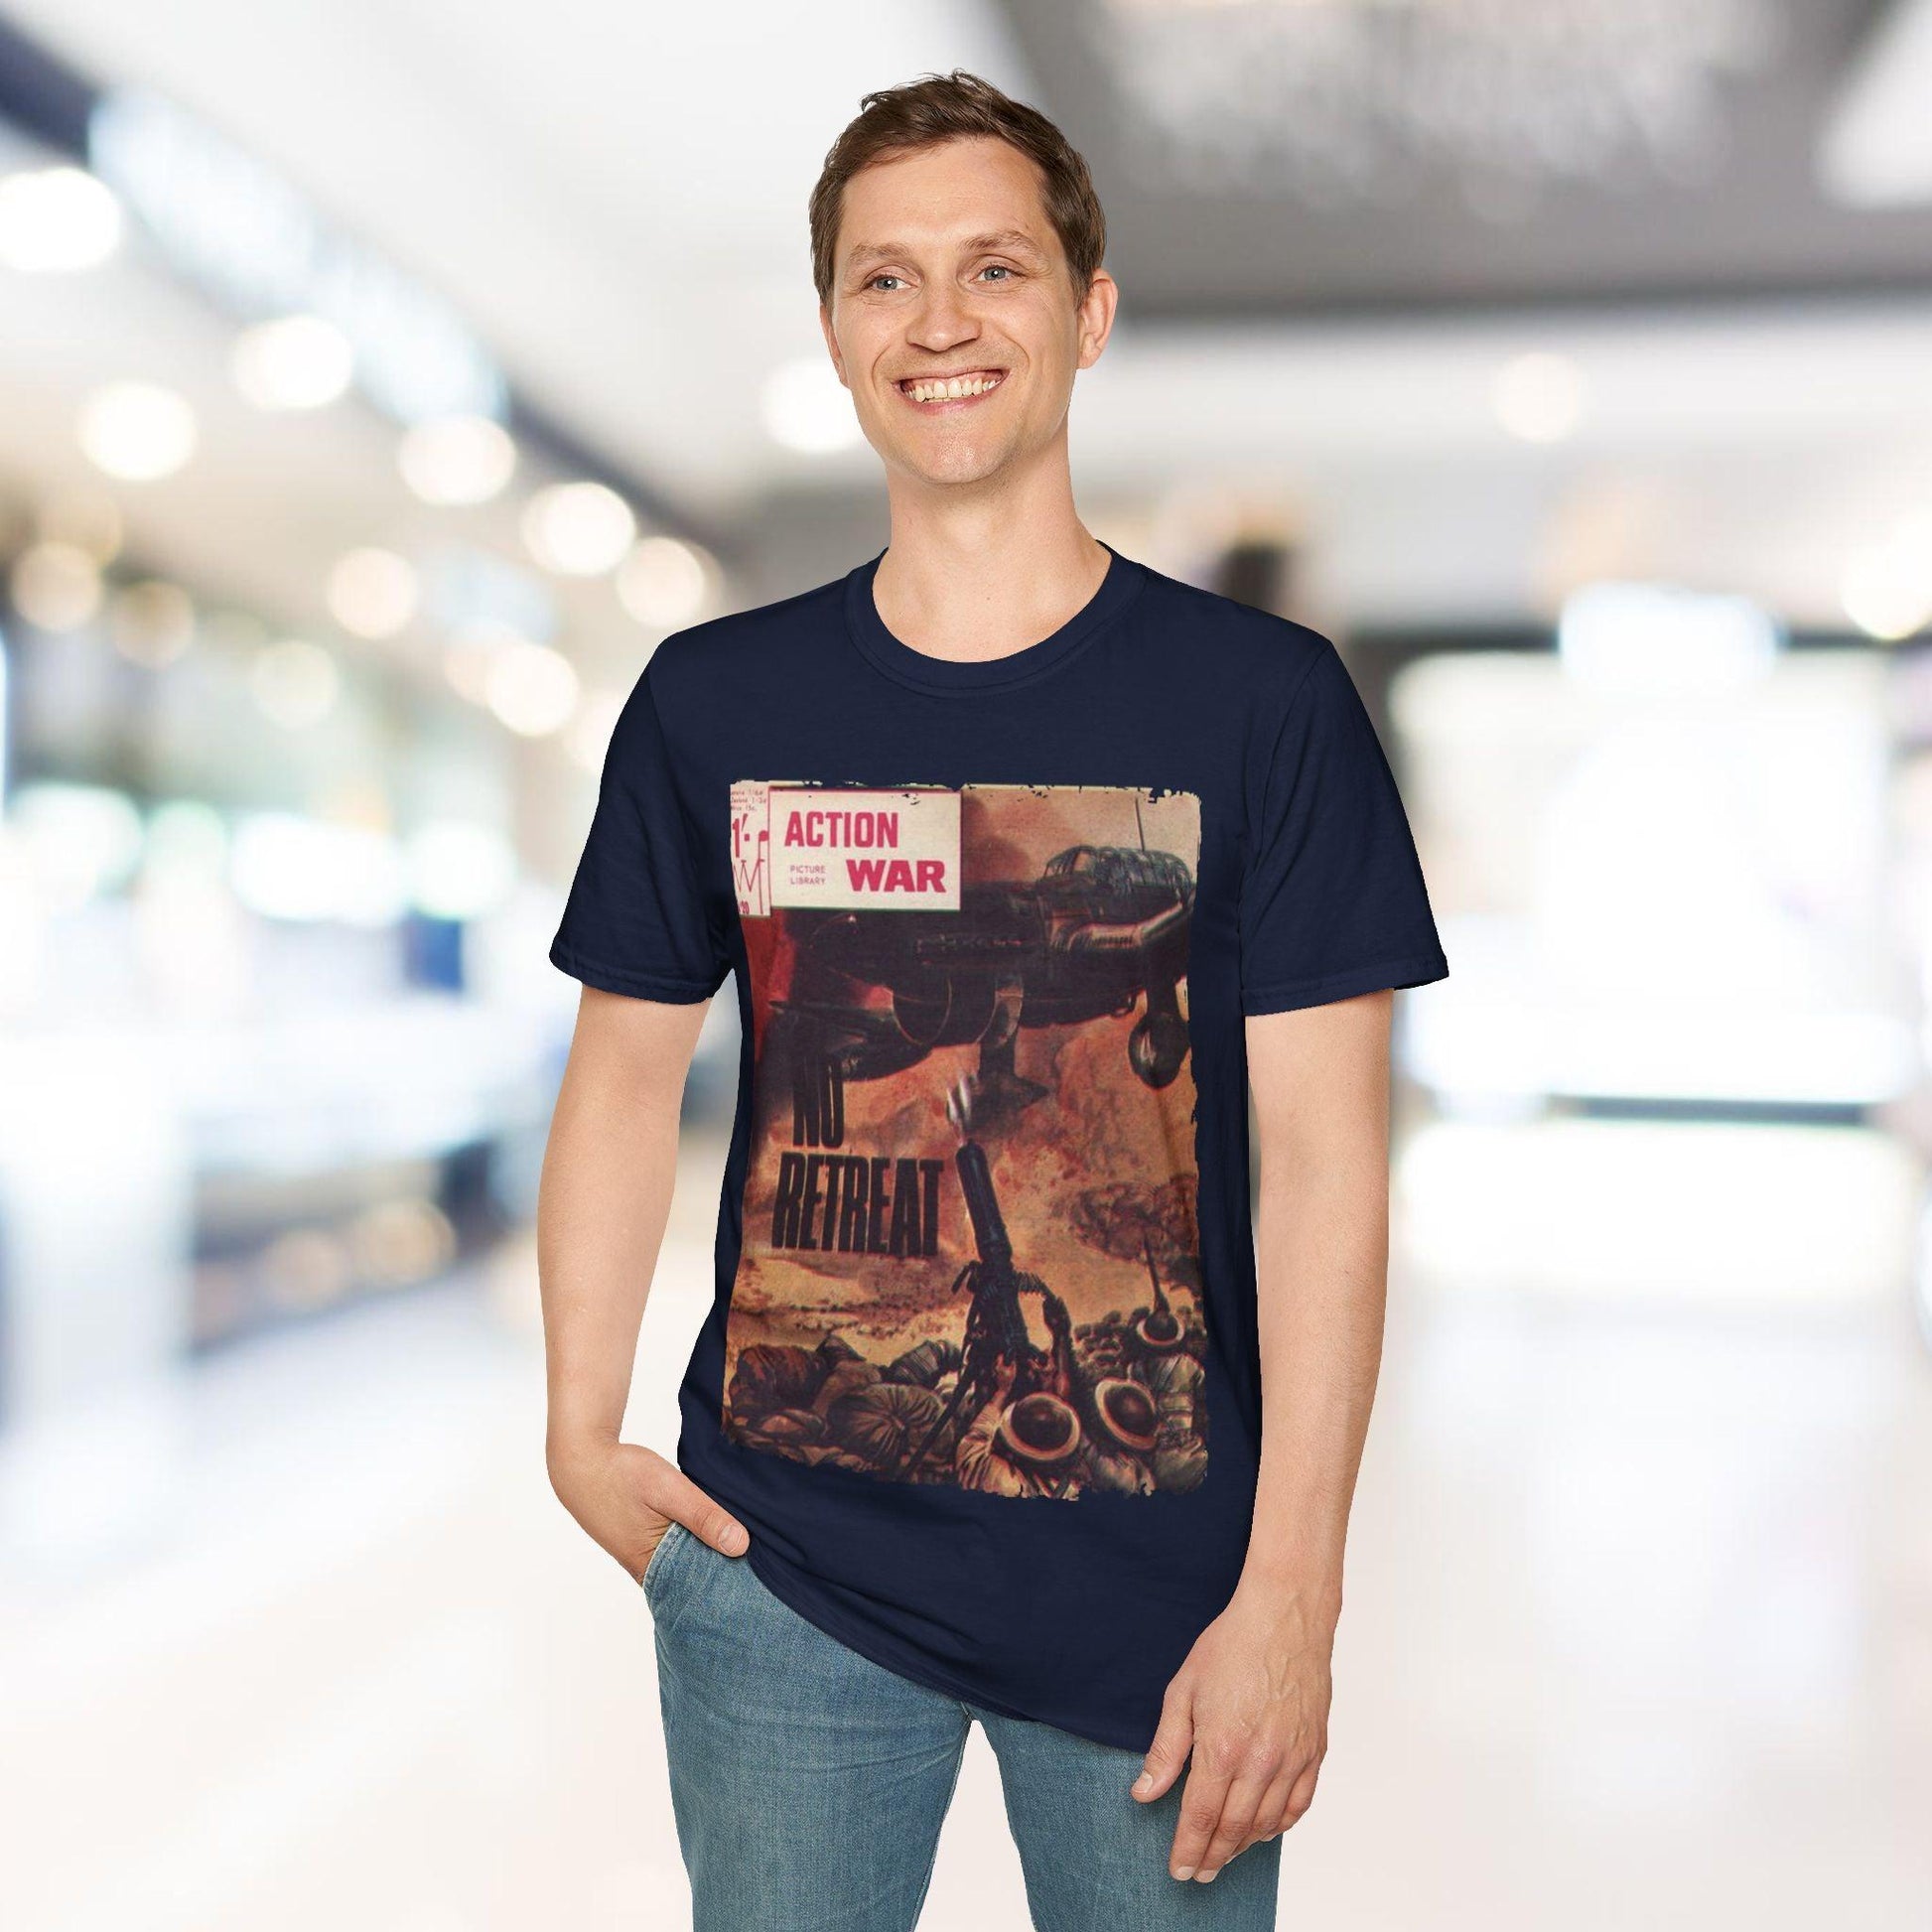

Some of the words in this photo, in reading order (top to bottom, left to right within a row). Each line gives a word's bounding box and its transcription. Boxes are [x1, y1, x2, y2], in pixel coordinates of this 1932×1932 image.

[783, 810, 898, 849] ACTION
[789, 865, 826, 874] PICTURE
[789, 877, 826, 886] LIBRARY
[846, 859, 946, 894] WAR
[792, 1054, 845, 1150] NO
[771, 1152, 944, 1257] RETREAT
